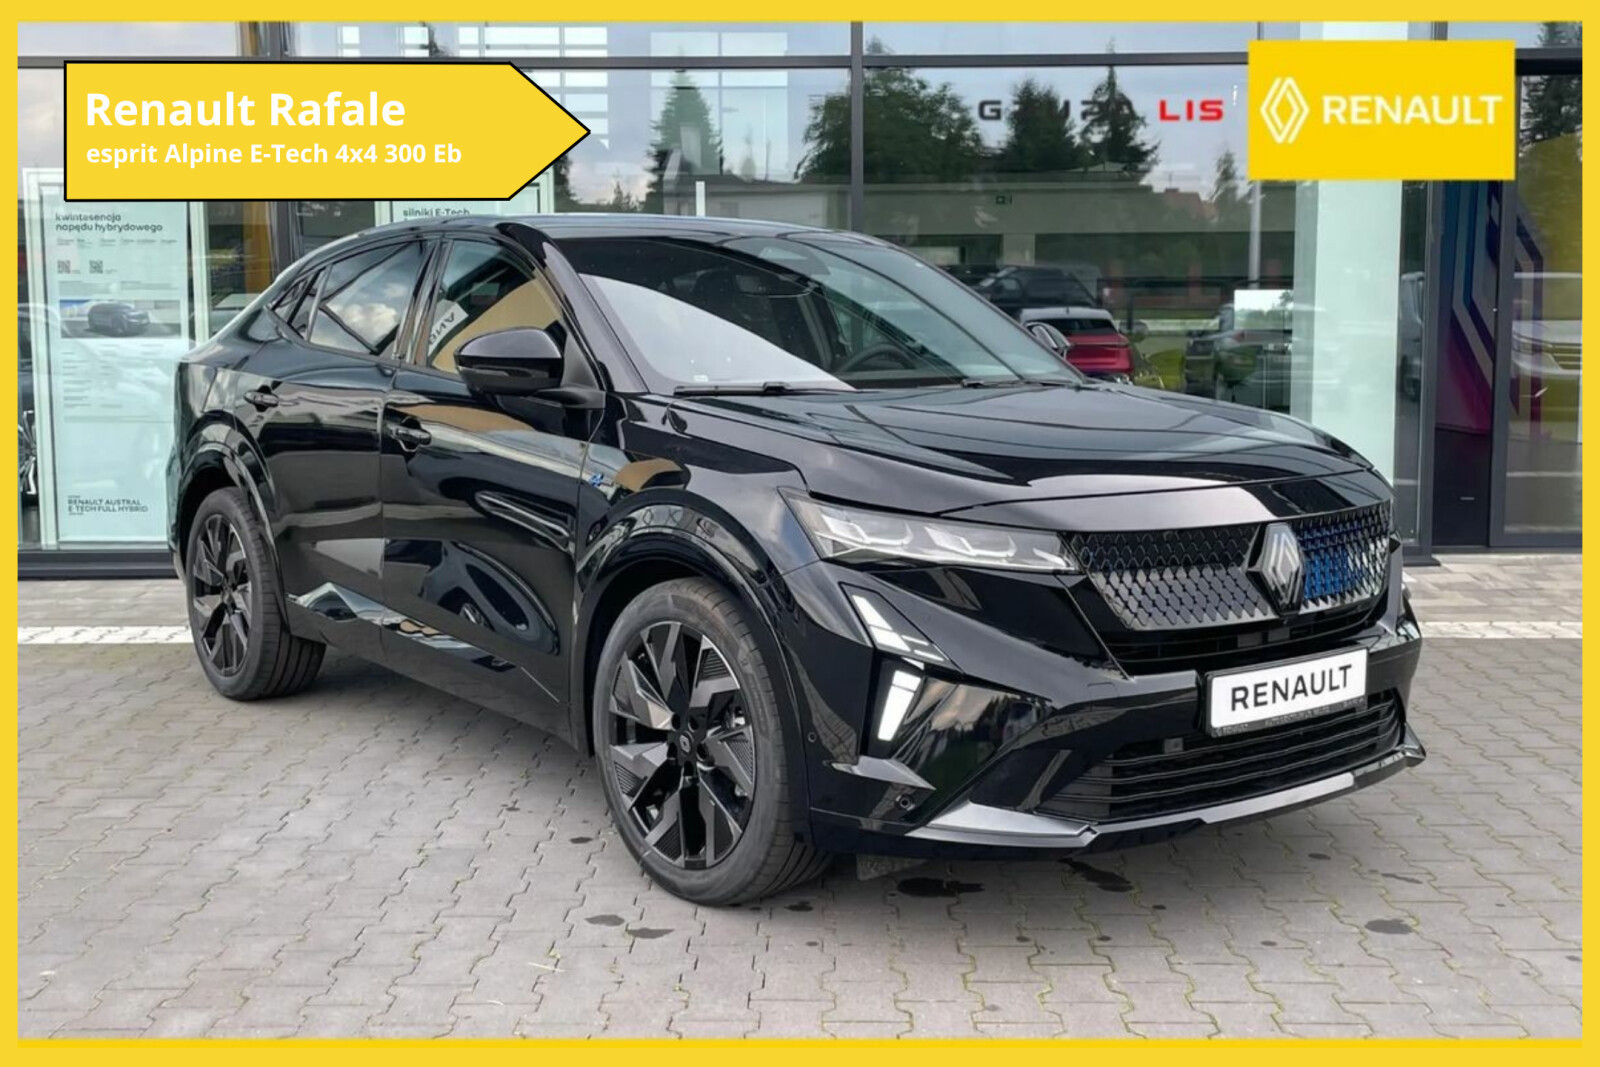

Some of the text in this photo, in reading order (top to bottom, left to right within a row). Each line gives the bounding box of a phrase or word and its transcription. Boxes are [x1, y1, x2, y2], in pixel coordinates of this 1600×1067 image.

[1158, 99, 1224, 122] LIS
[95, 222, 163, 233] hybrydowego
[1231, 665, 1352, 711] RENAULT
